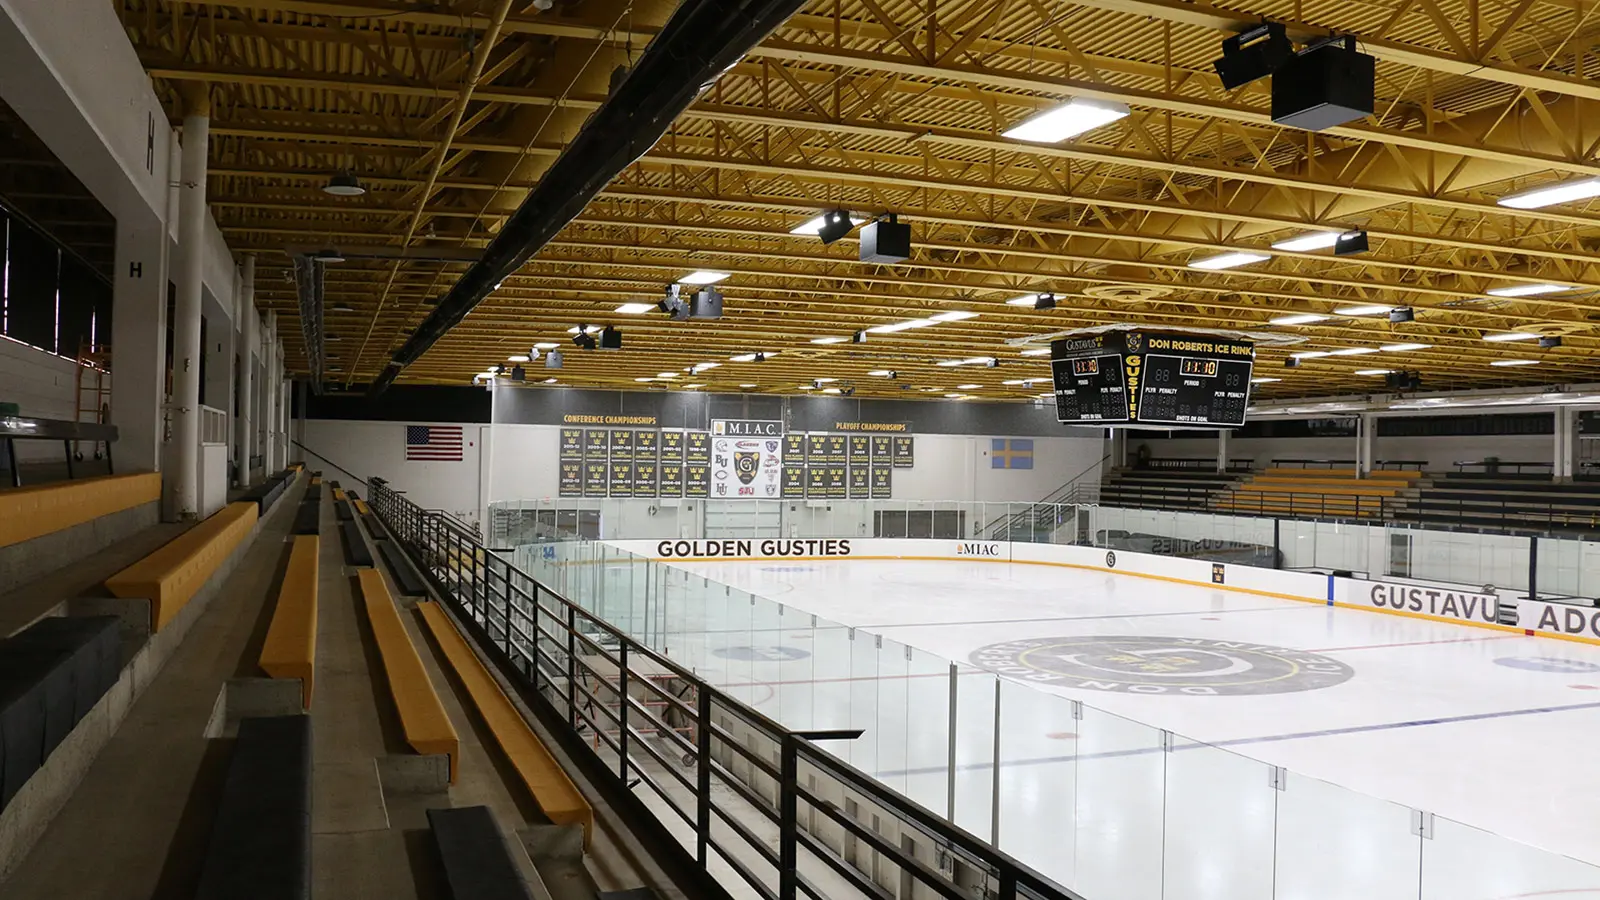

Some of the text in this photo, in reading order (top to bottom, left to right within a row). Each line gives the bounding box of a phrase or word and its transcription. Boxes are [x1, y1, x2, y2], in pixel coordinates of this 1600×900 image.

[130, 262, 142, 278] H
[1066, 338, 1096, 351] GUSTAVUS
[1149, 339, 1252, 356] DON ROBERTS ICE RINK
[1184, 360, 1216, 374] 11:10
[1125, 355, 1141, 419] GUSTIES
[1183, 379, 1200, 387] PERIOD
[1145, 386, 1178, 395] PLYR PENALTY
[1227, 391, 1246, 399] PENALTY
[563, 414, 657, 425] CONFERENCE CHAMPIONSHIPS
[1176, 414, 1189, 422] SHOTS
[1197, 415, 1209, 423] GOAL
[836, 422, 906, 432] PLAYOFF CHAMPIONSHIPS
[657, 540, 851, 557] GOLDEN GUSTIES
[964, 543, 999, 556] MIAC
[1371, 584, 1519, 623] GUSTAVU
